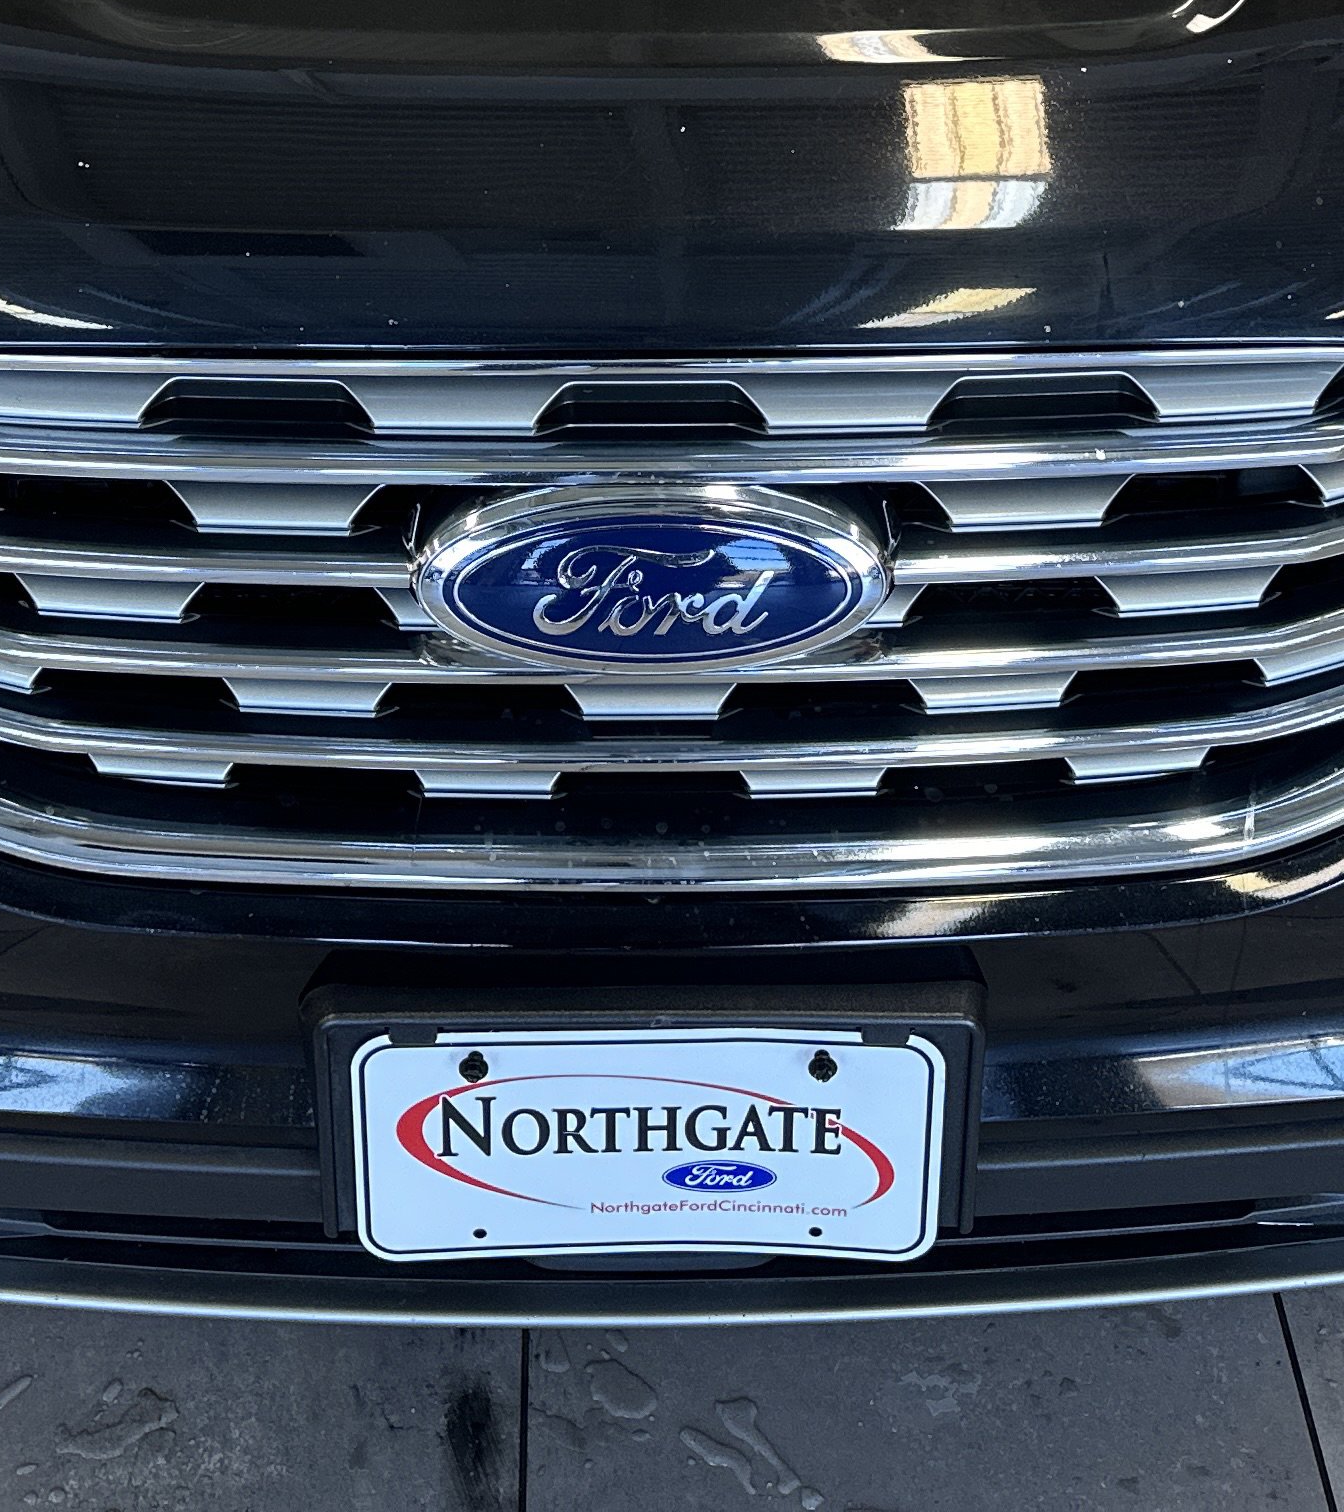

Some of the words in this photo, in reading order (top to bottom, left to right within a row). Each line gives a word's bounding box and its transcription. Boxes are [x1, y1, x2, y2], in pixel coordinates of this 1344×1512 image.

[532, 543, 775, 637] Ford
[684, 1164, 754, 1187] Ford
[590, 1198, 848, 1218] NorthgateFordCincinnati.com
